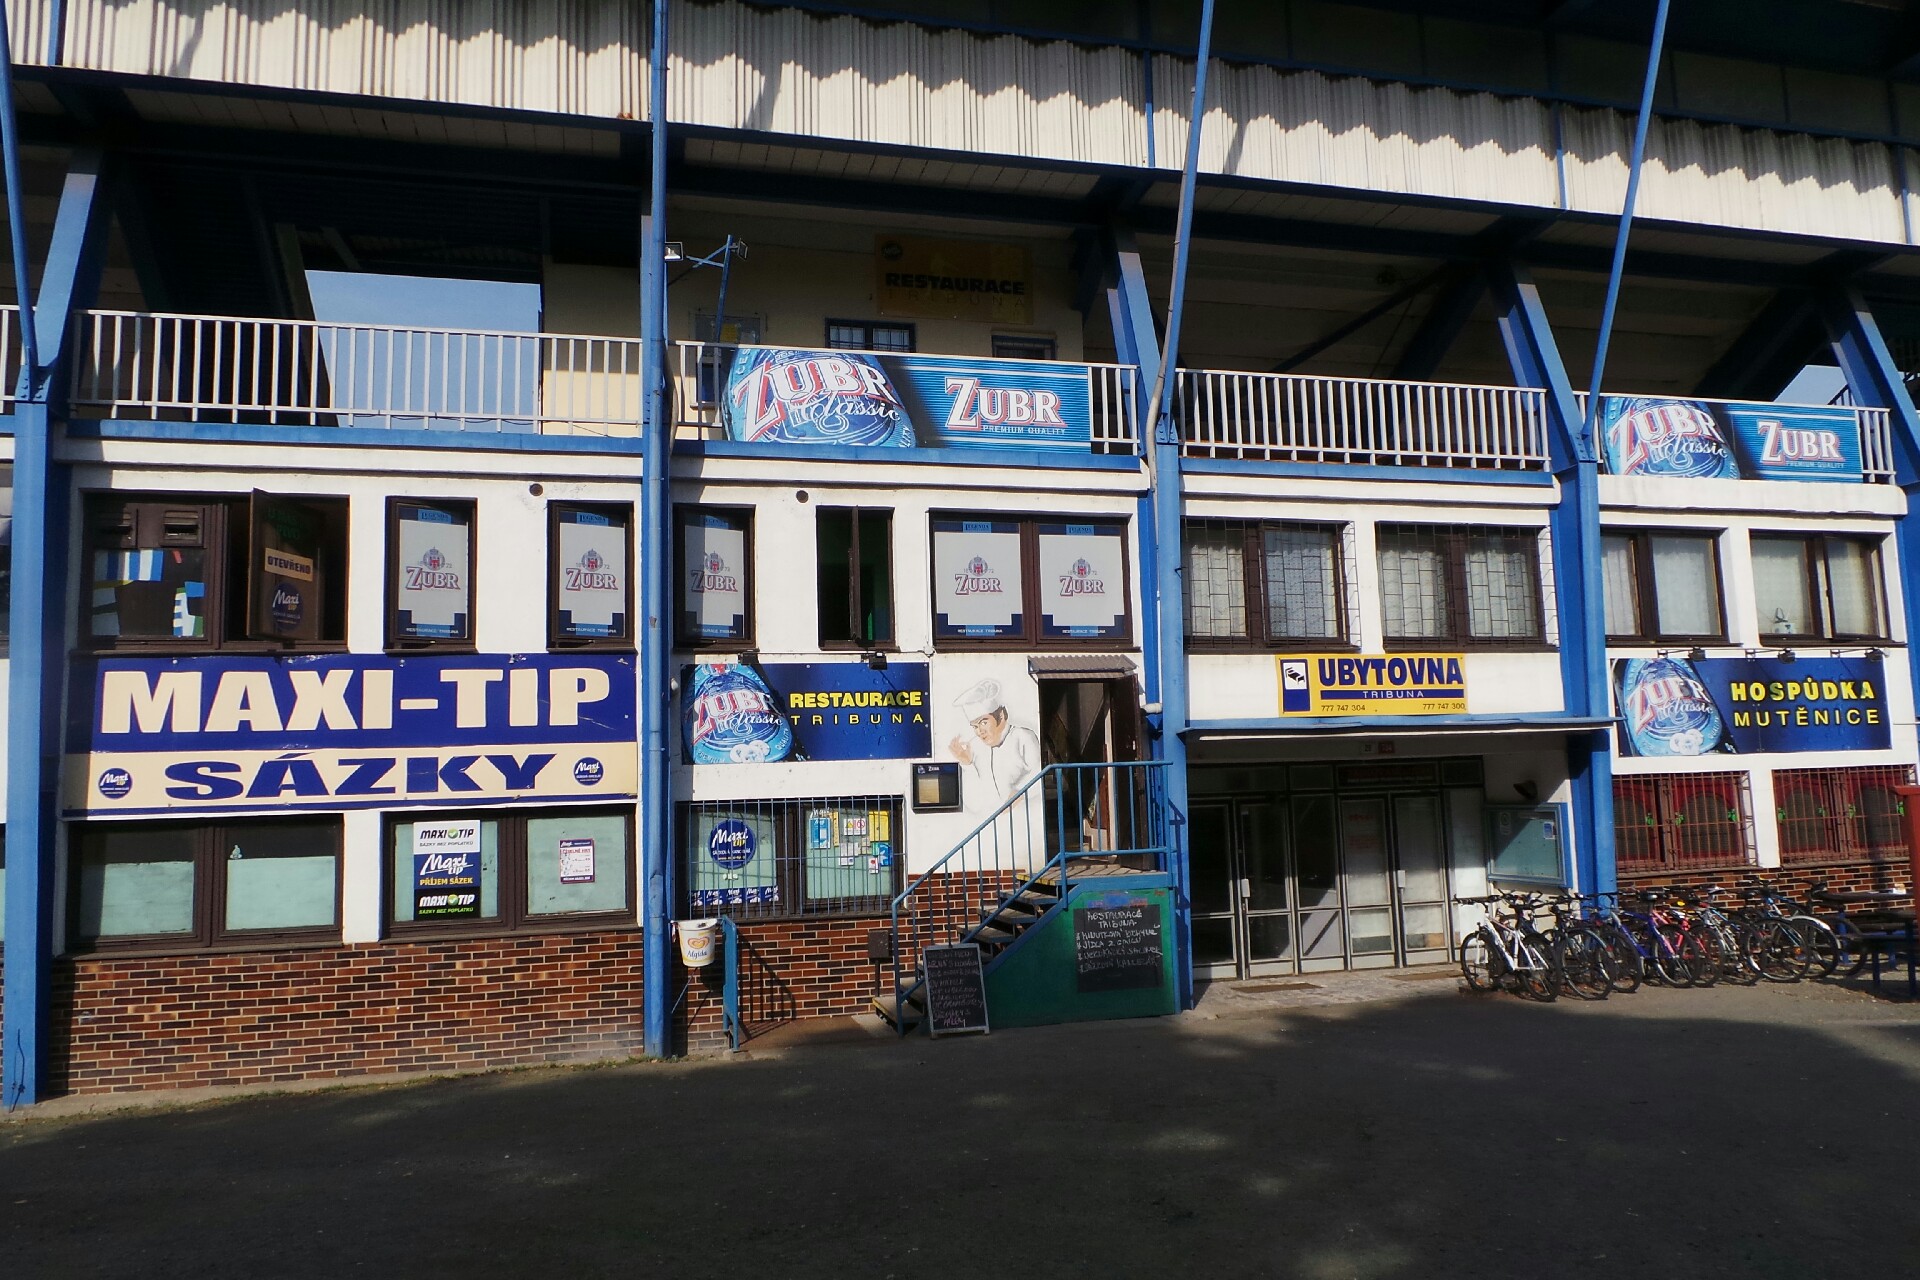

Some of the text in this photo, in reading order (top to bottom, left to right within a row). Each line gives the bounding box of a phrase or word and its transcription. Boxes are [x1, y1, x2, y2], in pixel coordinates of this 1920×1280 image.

[885, 272, 1025, 295] RESTAURACE
[889, 288, 1025, 308] TRIBUNA
[732, 356, 905, 442] ZUBR
[797, 389, 901, 421] Classic
[945, 376, 1068, 431] ZUBR
[983, 425, 1066, 435] PREMIUM QUALITY
[1608, 404, 1726, 476] ZUBR
[1757, 419, 1846, 467] ZUBR
[267, 555, 311, 575] OTEVŘENO
[405, 565, 461, 590] ZUBR
[565, 567, 618, 591] ZUBR
[691, 569, 738, 593] ZUBR
[954, 573, 1003, 596] ZUBR
[1059, 575, 1106, 597] ZUBR
[272, 589, 299, 608] Maxi
[1318, 657, 1464, 687] UBYTOVNA
[1363, 690, 1424, 699] TRIBUNA
[1730, 676, 1875, 701] HOSPŮDKA
[101, 667, 611, 734] MAXI-TIP
[789, 691, 922, 708] RESTAURACE
[1321, 704, 1334, 712] 777
[1337, 704, 1349, 712] 747
[1351, 704, 1366, 712] 304
[1452, 702, 1465, 710] 300
[790, 713, 924, 726] TRIBUNA
[1734, 706, 1880, 727] MUTĚNICE
[164, 751, 557, 800] SÁZKY
[575, 762, 600, 774] Maxi
[100, 773, 129, 787] Maxi
[420, 828, 475, 840] MAXI TIP
[711, 827, 748, 849] Maxi
[420, 853, 468, 876] Maxi
[448, 866, 464, 876] tip
[420, 875, 474, 886] PŘÍJEM SÁZEK
[419, 894, 476, 907] MAXI TIP
[1087, 909, 1143, 921] RESTAURACE
[687, 950, 708, 960] Algida
